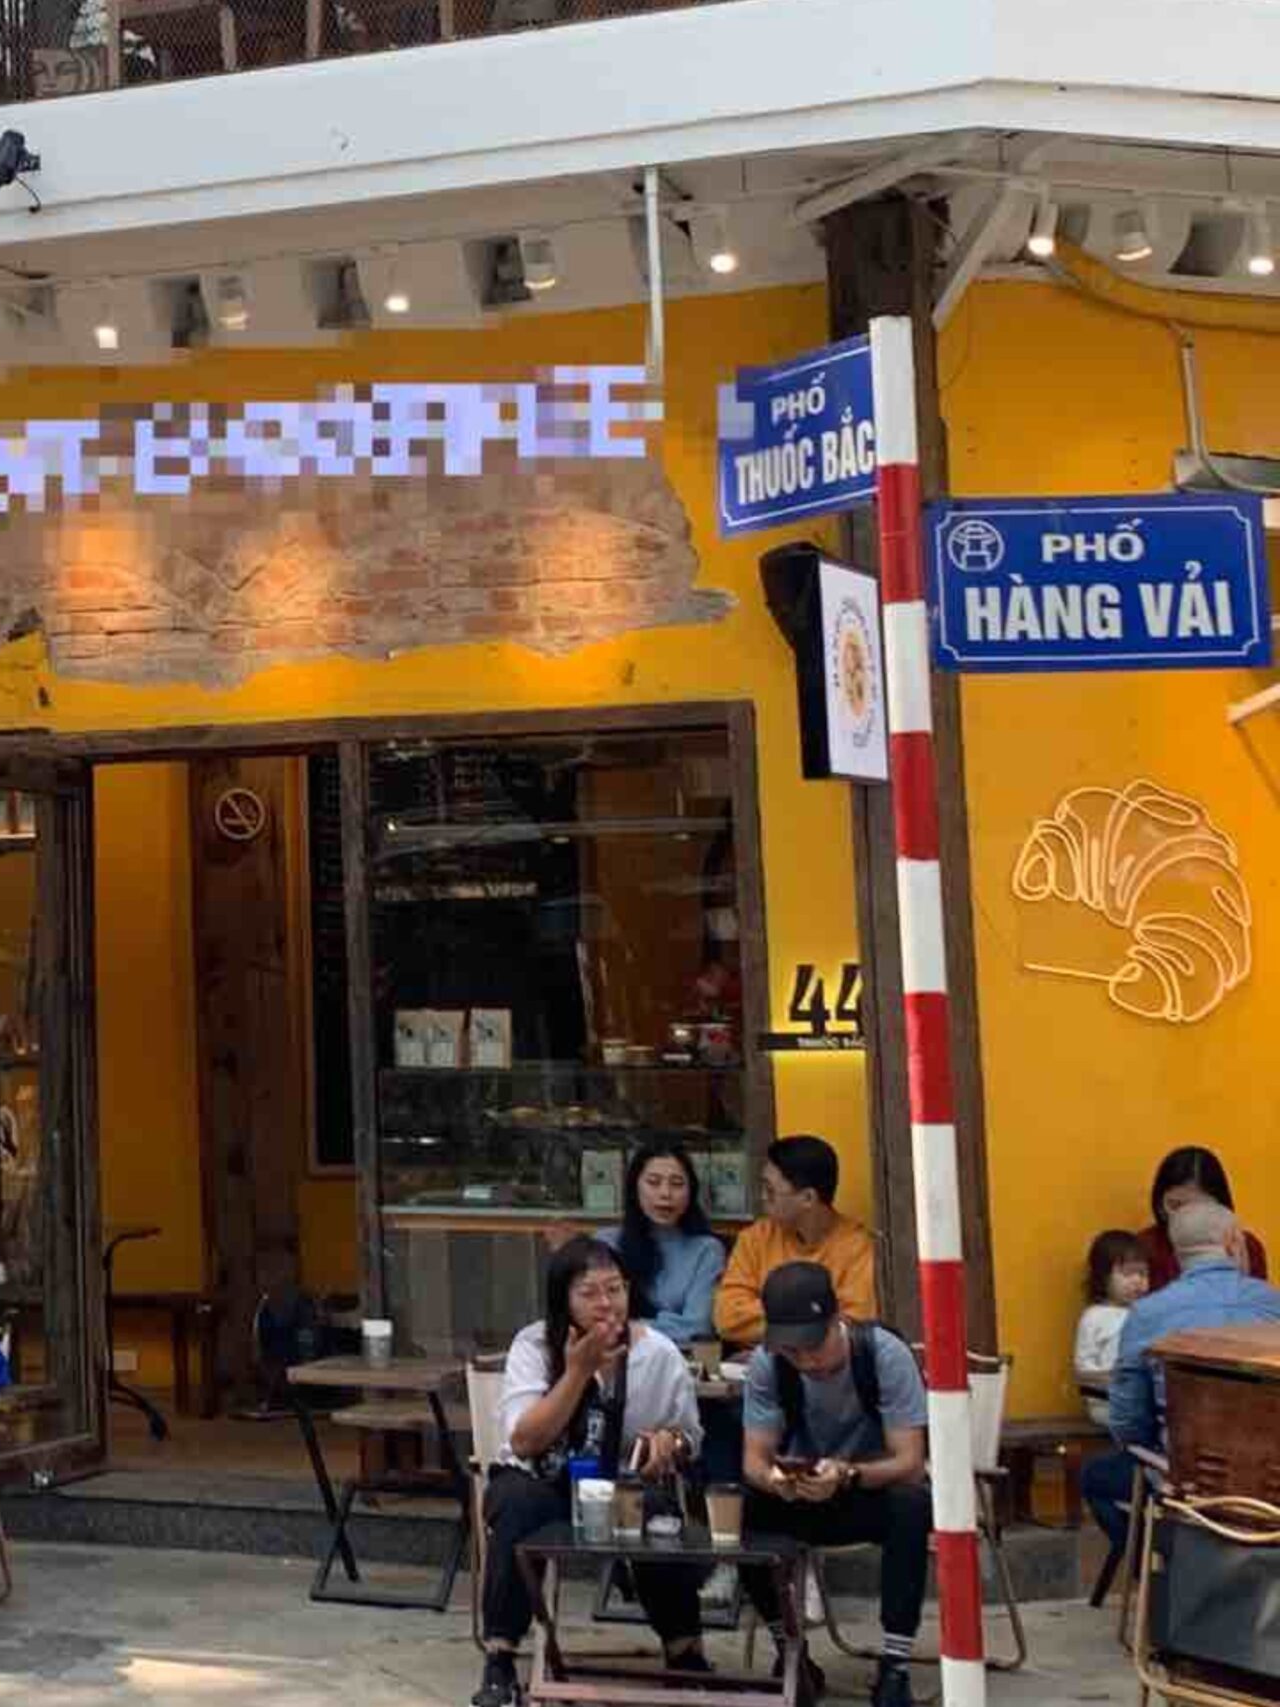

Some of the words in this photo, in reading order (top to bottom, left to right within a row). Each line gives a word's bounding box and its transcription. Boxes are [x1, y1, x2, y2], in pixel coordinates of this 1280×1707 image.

[771, 372, 825, 427] PHỐ
[735, 423, 815, 506] THUỐC
[821, 405, 875, 484] BẮC
[1041, 518, 1145, 563] PHỐ
[964, 573, 1124, 642] HÀNG
[1138, 560, 1234, 639] VẢI
[789, 964, 864, 1036] 44
